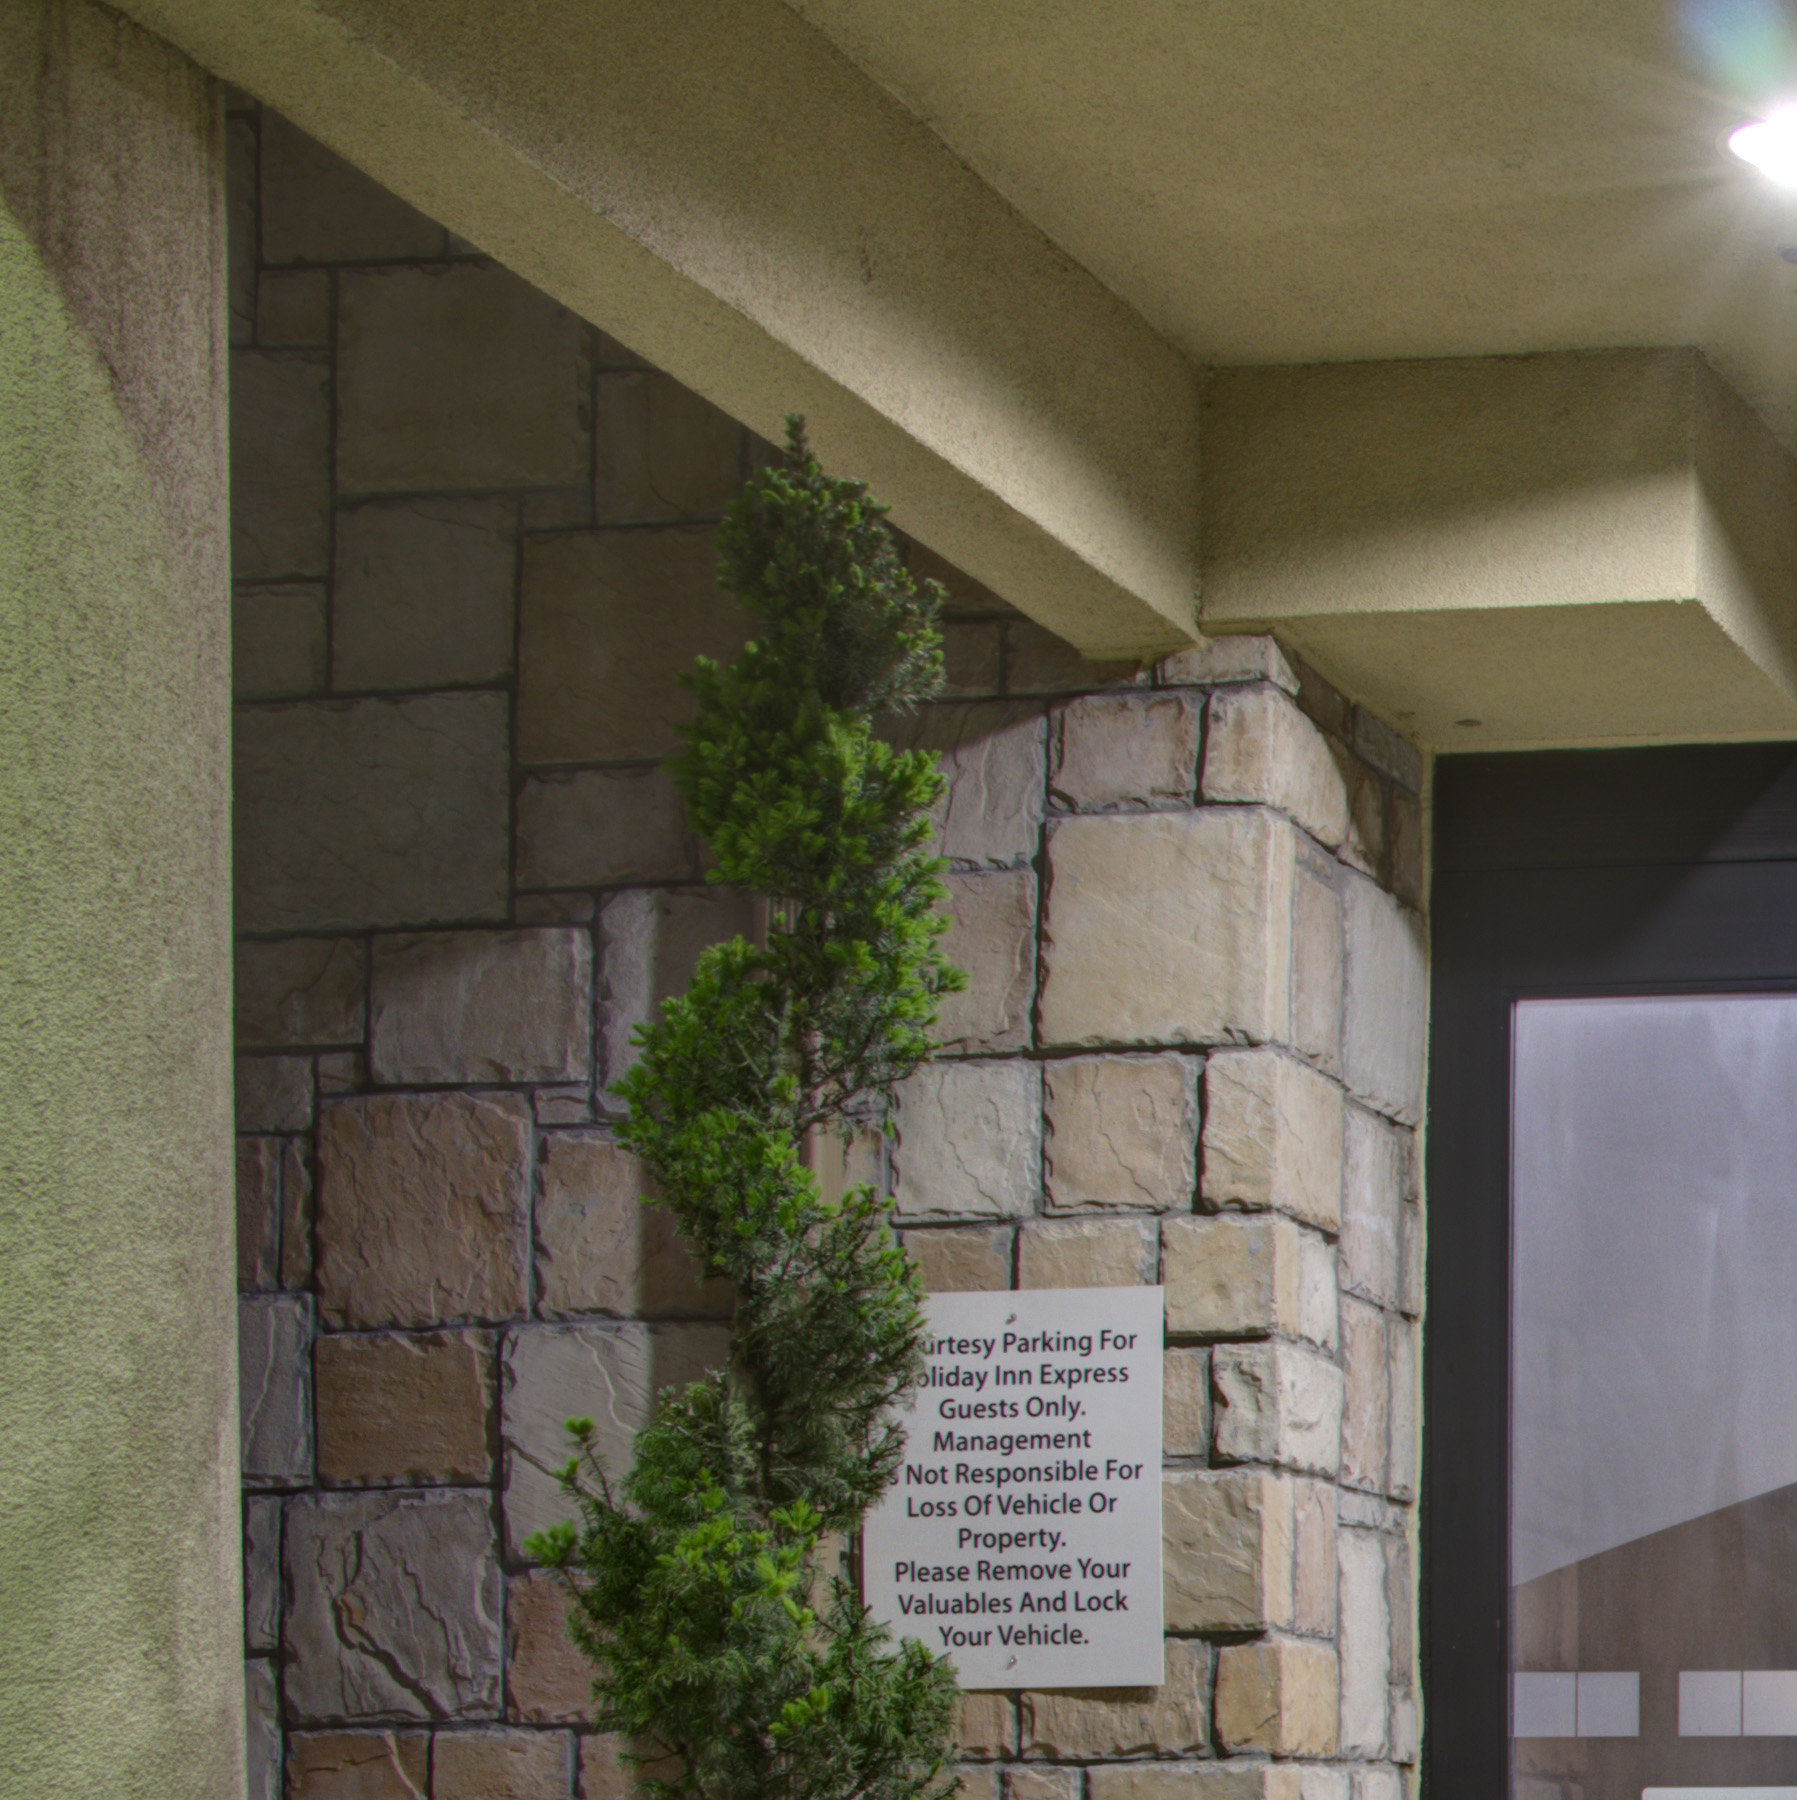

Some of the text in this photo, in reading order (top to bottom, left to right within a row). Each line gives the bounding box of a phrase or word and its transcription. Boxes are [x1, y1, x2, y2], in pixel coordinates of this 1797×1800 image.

[918, 1329, 1138, 1361] urtesy Parking For
[920, 1363, 1129, 1392] oliday Inn Express
[939, 1394, 1086, 1422] Guests Only.
[933, 1430, 1092, 1457] Management
[906, 1464, 948, 1485] Not
[955, 1459, 1098, 1489] Responsible
[1106, 1459, 1144, 1480] For
[907, 1491, 1118, 1518] Loss Of Vehicle Or
[958, 1527, 1066, 1554] Property.
[895, 1558, 1131, 1583] Please Remove Your
[898, 1589, 1128, 1615] Valuables And Lock
[938, 1623, 1089, 1647] Your Vehicle.
